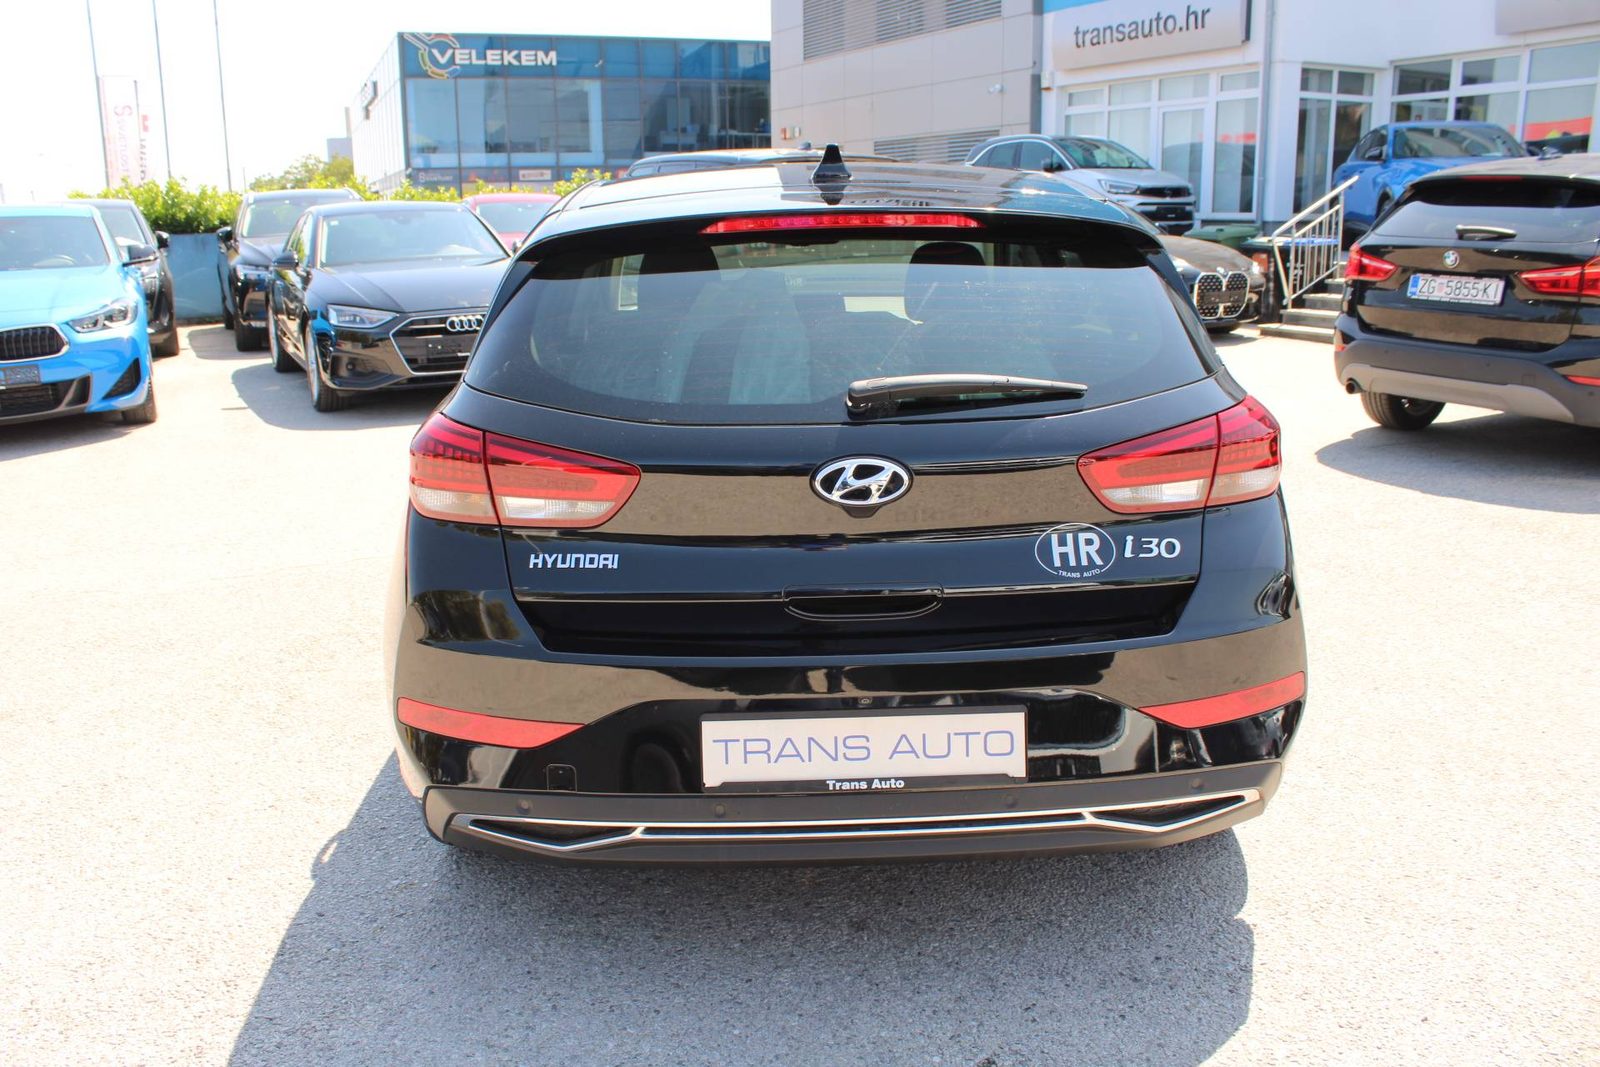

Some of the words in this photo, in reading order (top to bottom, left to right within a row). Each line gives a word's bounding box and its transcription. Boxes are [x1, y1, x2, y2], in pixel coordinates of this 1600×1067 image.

[1074, 5, 1211, 48] transauto.hr
[431, 48, 558, 66] VELEKEM
[1418, 278, 1437, 295] ZG
[1051, 532, 1104, 567] HR
[1124, 535, 1181, 558] i30
[529, 553, 619, 569] HYUNDAI
[1058, 569, 1081, 579] TRANS
[1083, 568, 1101, 578] AUTO
[712, 734, 871, 765] TRANS
[888, 729, 1015, 760] AUTO
[826, 779, 868, 790] Trans
[871, 777, 905, 790] Auto
